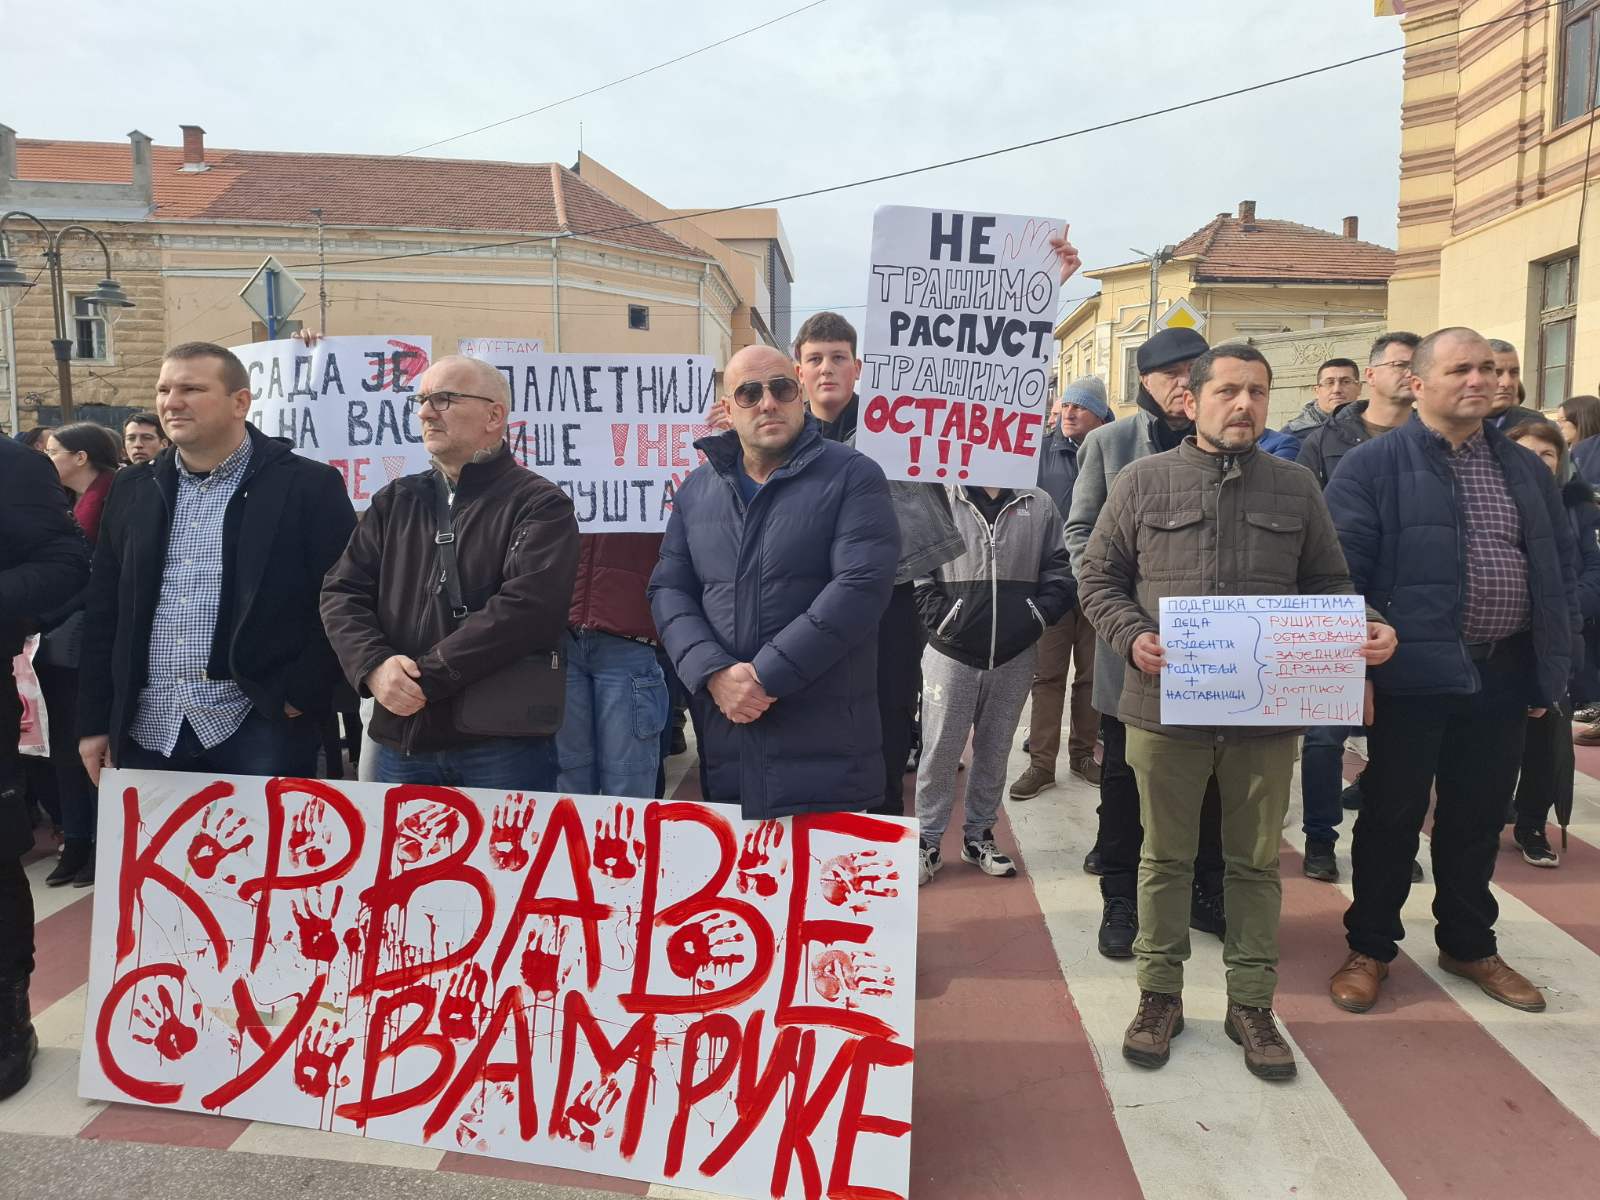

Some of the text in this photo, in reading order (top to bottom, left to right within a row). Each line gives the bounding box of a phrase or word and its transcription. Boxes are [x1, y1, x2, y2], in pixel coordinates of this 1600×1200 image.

[929, 212, 996, 265] НЕ
[872, 264, 1053, 315] ТРАЖИМО
[889, 310, 1054, 363] РАСПУСТ,
[248, 350, 418, 403] САДА ЈЕ
[864, 353, 1047, 409] ТРАЖИМО
[278, 406, 320, 449] НА
[348, 400, 425, 447] ВАС
[863, 395, 1043, 457] ОСТАВКЕ
[906, 436, 975, 481] !!!
[1167, 597, 1354, 613] ПОДРШКА СТУДЕНТИМА
[1172, 617, 1211, 629] ДЕЦА
[1166, 640, 1236, 650] СТУДЕНТИ
[1167, 663, 1238, 675] РОДИТЕЉИ
[1166, 689, 1246, 702] НАСТАВНИЦИ
[116, 777, 913, 1039] КРВАВЕ
[97, 962, 914, 1200] СУ ВАМ РУКЕ
